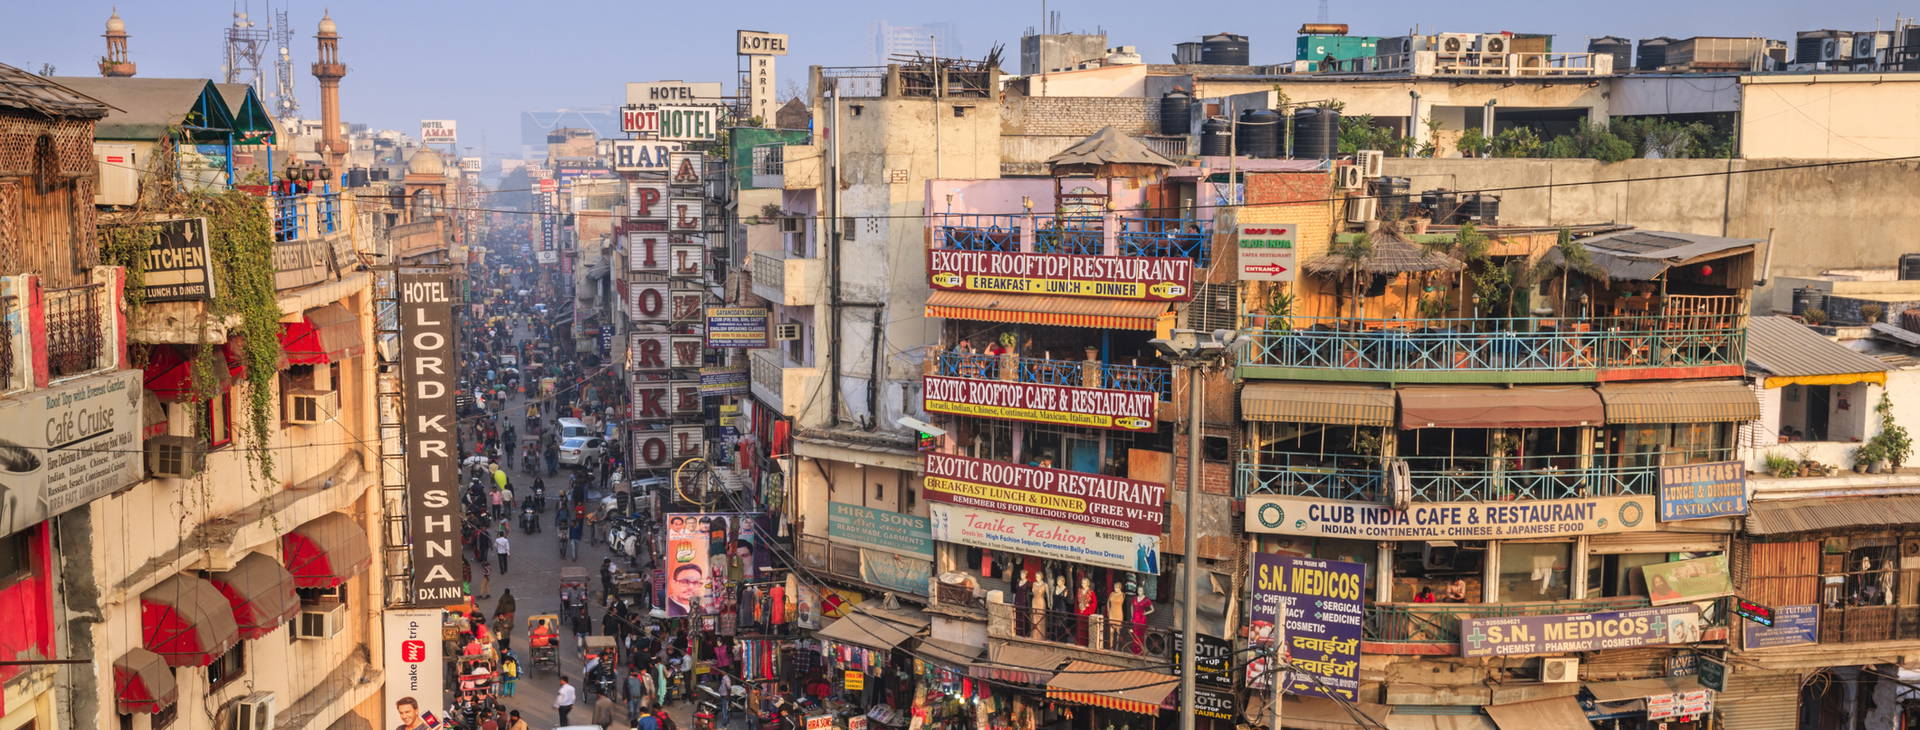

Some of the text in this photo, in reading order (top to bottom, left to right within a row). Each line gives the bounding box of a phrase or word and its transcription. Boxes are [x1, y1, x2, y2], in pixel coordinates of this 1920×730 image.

[743, 36, 785, 50] HOTEL
[650, 87, 695, 99] HOTEL
[624, 112, 659, 130] HOT
[660, 109, 714, 138] HOTEL
[617, 145, 680, 168] HAR
[1266, 239, 1292, 248] INDIA
[931, 251, 1188, 281] EXOTIC ROOFTOP RESTAURANT
[147, 284, 206, 298] LUNCH & DINNER
[403, 282, 449, 303] HOTEL
[973, 277, 1137, 296] BREAKFAST LUNCH DINNER
[925, 378, 1152, 418] EXOTIC ROOFTOP CAFE & RESTAURANT
[46, 405, 114, 447] Café Cruise
[413, 308, 455, 583] LORD KRISHNA
[927, 454, 1165, 507] EXOTIC ROOFTOP RESTAURANT
[1664, 463, 1742, 485] BREAKFAST
[927, 478, 1083, 510] BREAKFAST LUNCH & DINNER
[1664, 485, 1695, 501] LUNCH
[1697, 485, 1705, 498] &
[838, 505, 875, 520] HIRA
[880, 512, 925, 529] SONS
[953, 494, 1130, 529] REMEMBER US FOR DELICIOUS FOOD SERVICES
[1089, 501, 1164, 525] (FREE WI-FI)
[1308, 502, 1597, 525] CLUB INDIA CAFE & RESTAURANT
[1675, 501, 1734, 516] ENTRANCE
[964, 513, 1087, 545] Tanika Fashion
[1000, 534, 1020, 543] Fashion
[1321, 523, 1584, 537] INDIAN CONTINENTAL CHINESE & JAPANESE FOOD
[1258, 563, 1360, 601] S.N. MEDICOS
[1322, 600, 1362, 614] SERGICAL
[408, 621, 420, 639] trip
[1286, 620, 1326, 633] COSMETIC
[1321, 612, 1361, 626] MEDICINE
[1487, 624, 1536, 644] S.N.
[1544, 617, 1649, 641] MEDICOS
[1496, 643, 1536, 655] CHEMIST
[1545, 640, 1593, 652] PHARMACY
[1601, 637, 1642, 648] COSMETIC
[408, 664, 417, 691] make
